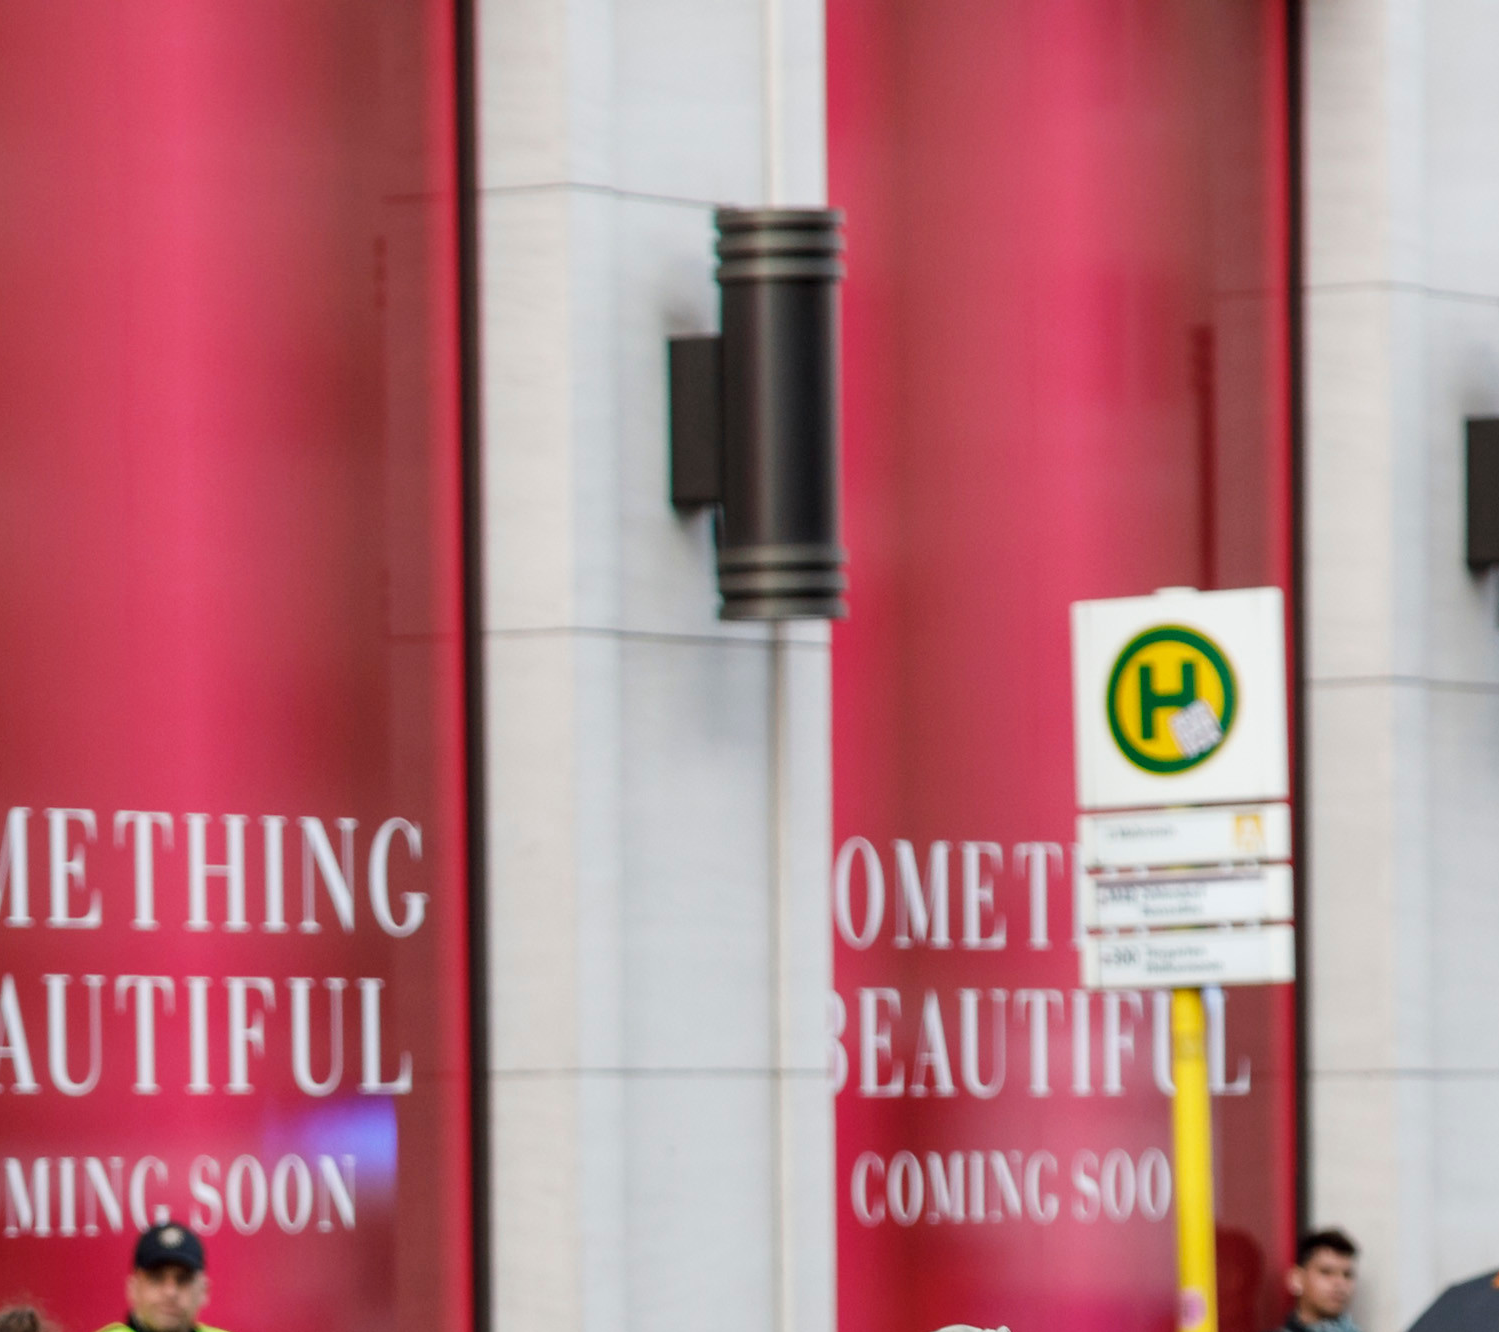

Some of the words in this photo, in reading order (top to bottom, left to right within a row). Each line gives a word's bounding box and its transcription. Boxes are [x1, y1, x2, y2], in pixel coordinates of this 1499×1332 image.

[834, 835, 1080, 951] OMET
[189, 1153, 358, 1236] SOON
[850, 1150, 1060, 1227] COMING
[1070, 1146, 1173, 1223] SOO
